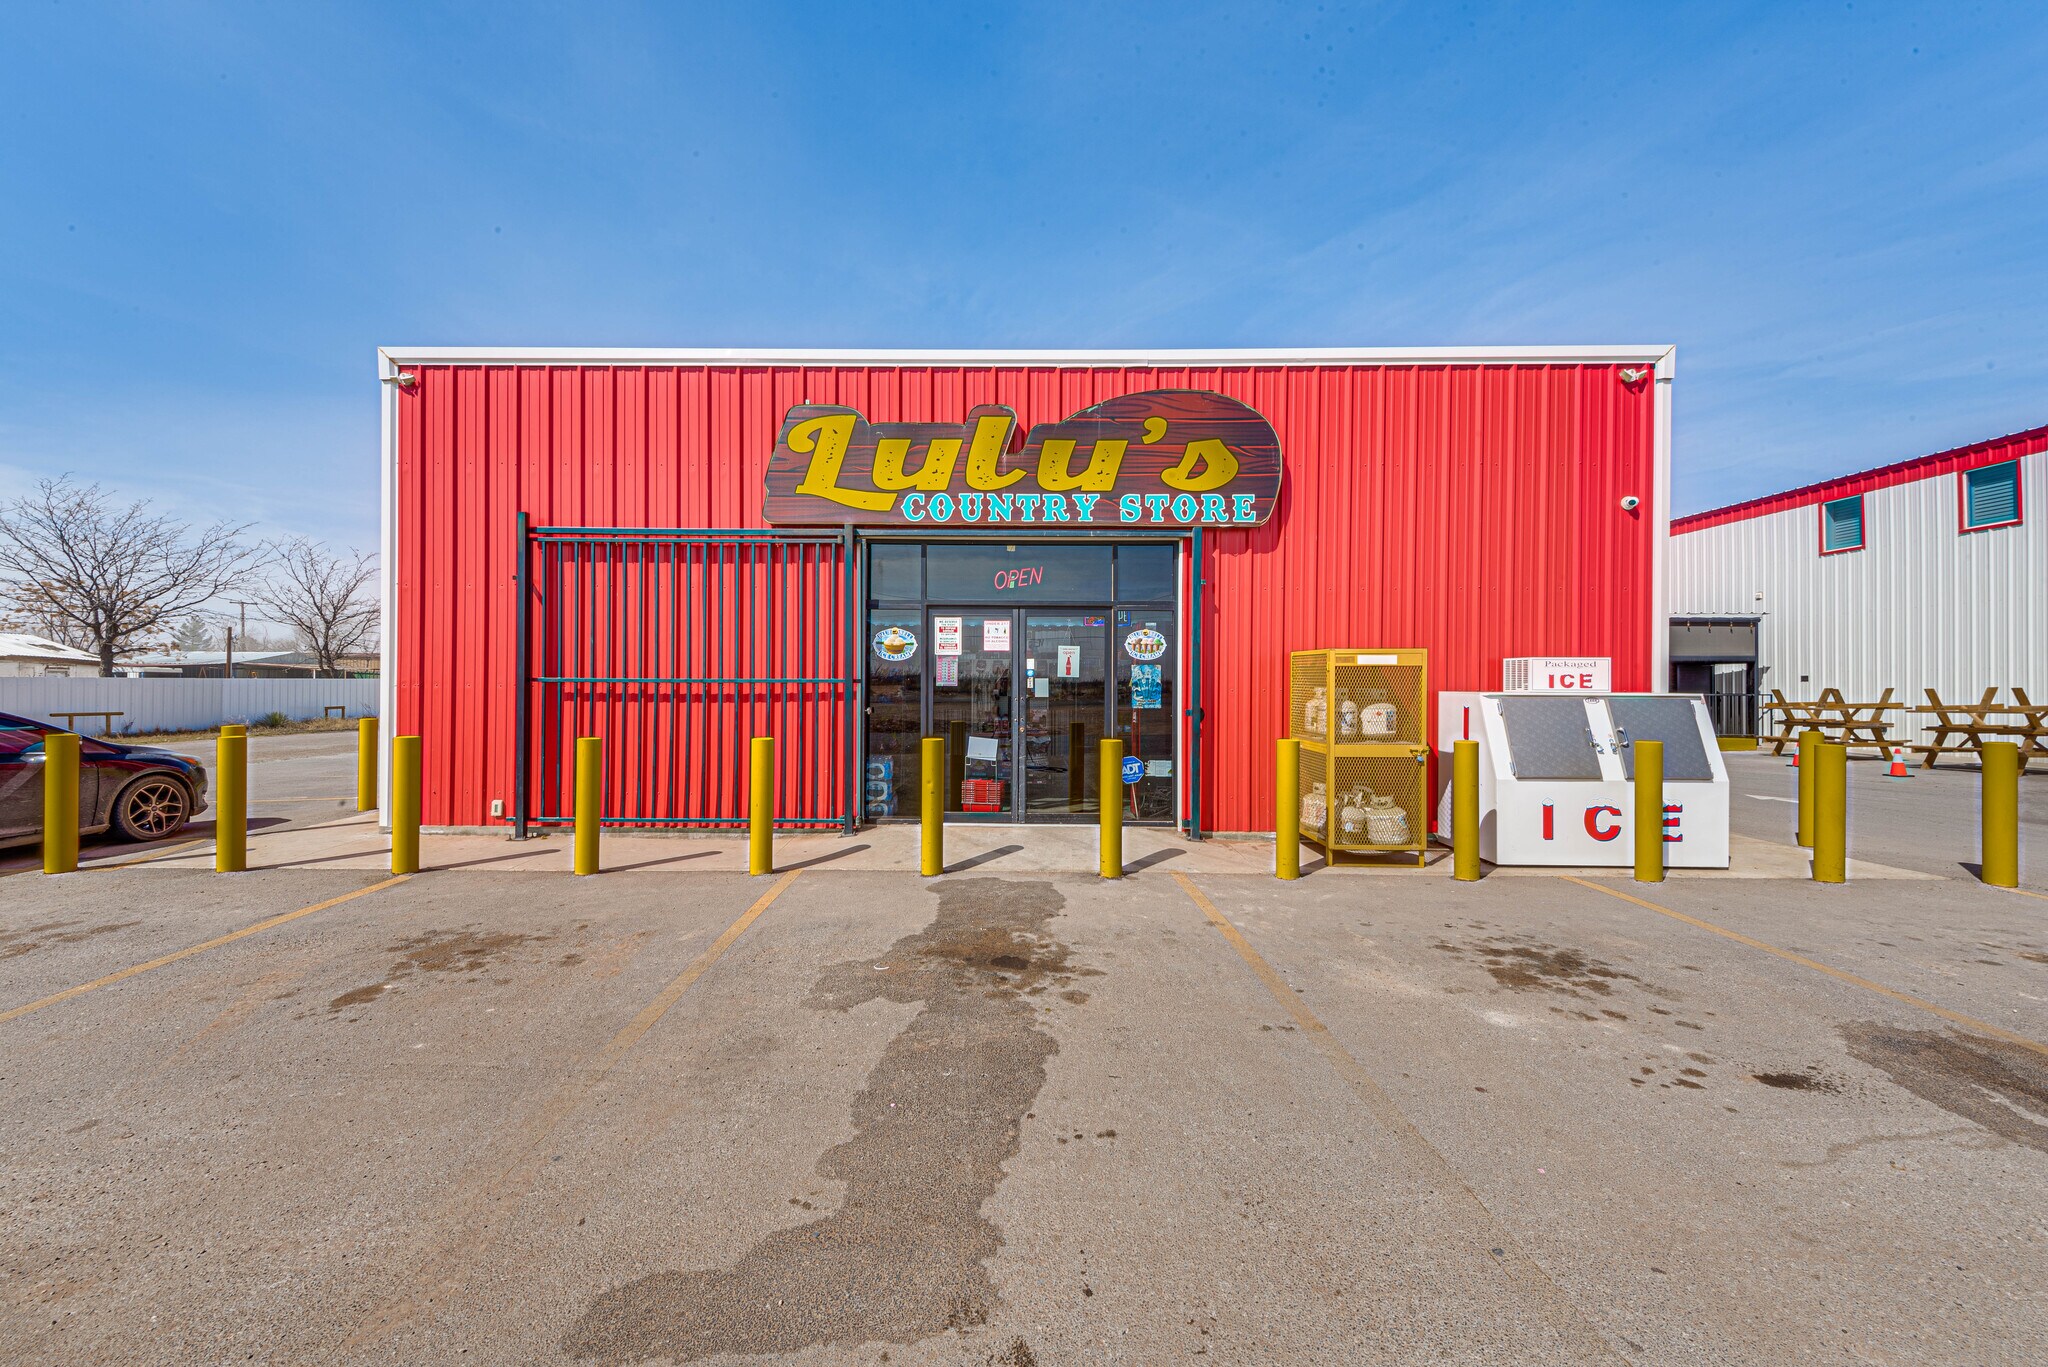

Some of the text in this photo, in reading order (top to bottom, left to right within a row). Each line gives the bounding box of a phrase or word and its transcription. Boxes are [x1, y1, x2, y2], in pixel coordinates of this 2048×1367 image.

[787, 414, 1239, 511] Lulu's
[901, 493, 1256, 522] COUNTRY STORE
[994, 566, 1043, 589] OPEN
[1545, 661, 1597, 669] Packaged
[1549, 673, 1593, 688] ICE
[1122, 763, 1140, 775] ADT
